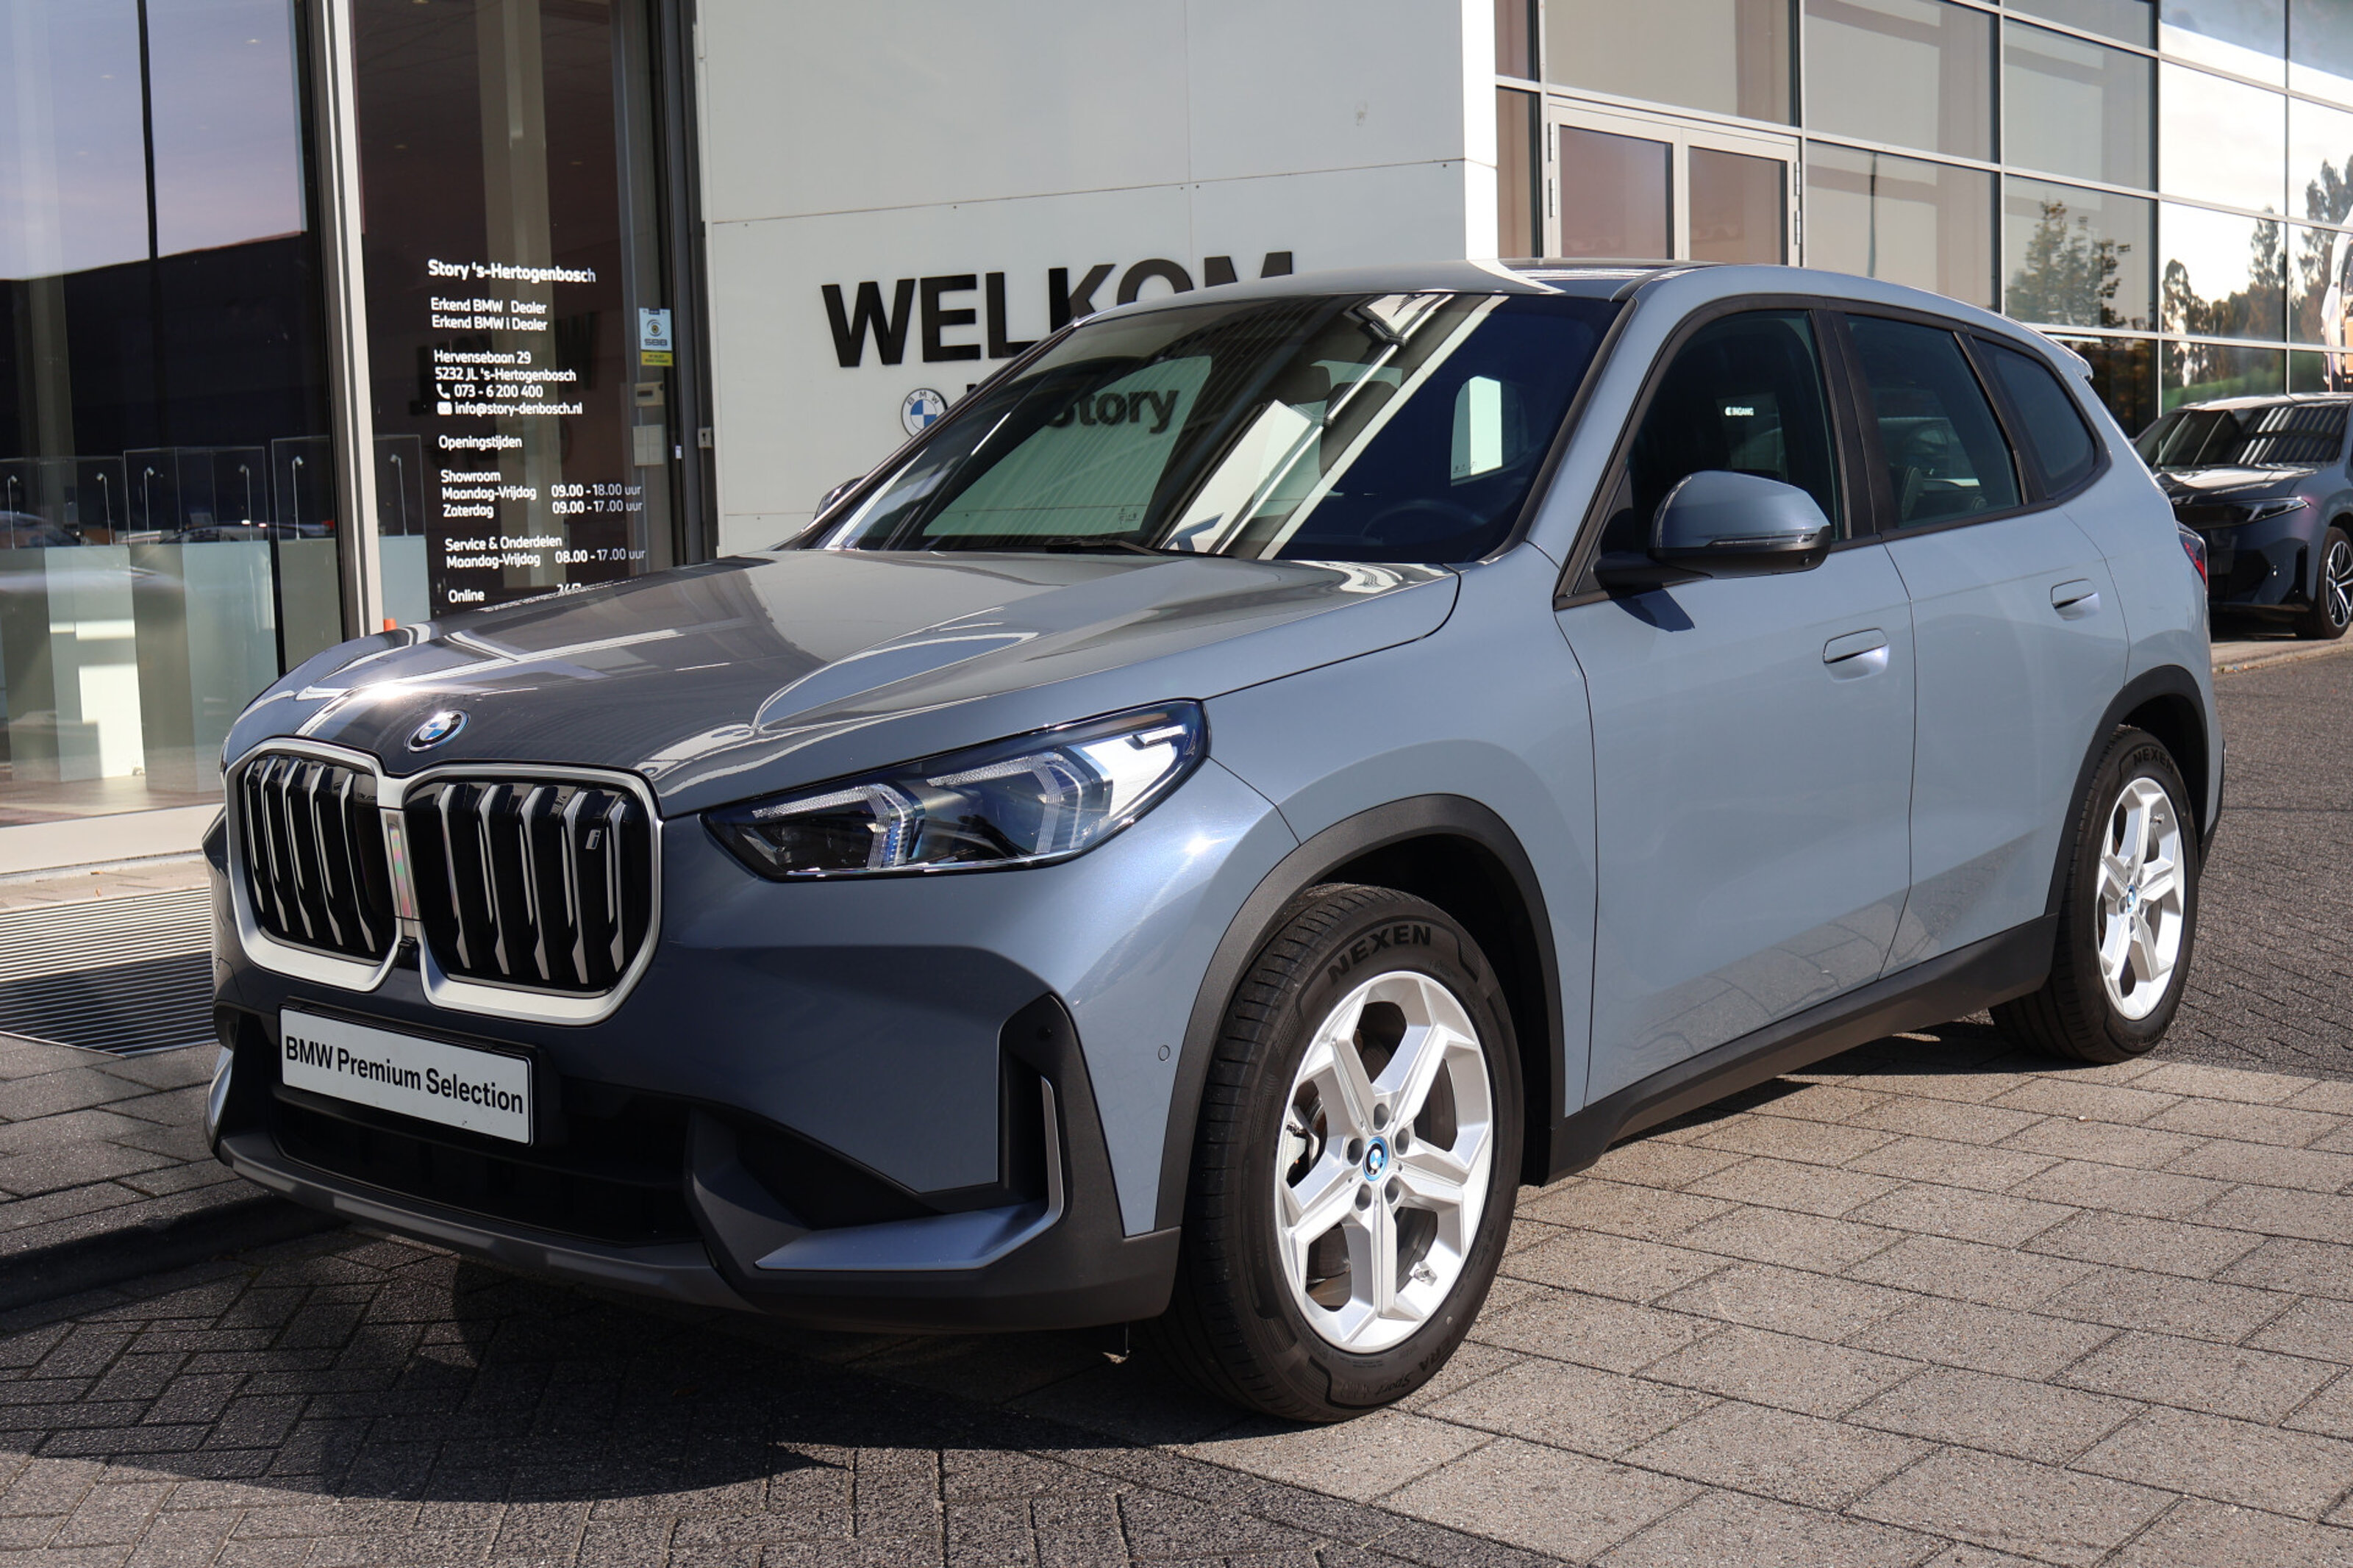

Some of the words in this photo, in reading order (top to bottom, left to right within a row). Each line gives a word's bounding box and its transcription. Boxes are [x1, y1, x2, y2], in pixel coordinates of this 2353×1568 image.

[427, 259, 470, 281] Story
[430, 297, 471, 312] Erkend
[473, 298, 503, 313] BMW
[510, 300, 548, 315] Dealer
[432, 315, 472, 330] Erkend
[474, 316, 504, 331] BMW
[506, 317, 510, 331] i
[512, 317, 549, 332] Dealer
[434, 349, 515, 365] Hervensebaan
[516, 351, 532, 365] 29
[435, 367, 464, 382] 5232
[465, 368, 479, 382] JL
[454, 384, 476, 398] 073
[486, 384, 494, 398] 6
[496, 384, 519, 398] 200
[521, 384, 544, 398] 400
[907, 391, 940, 406] BMW
[454, 401, 583, 418] info@story-denbosch.nl
[438, 435, 523, 451] Openingstijden
[440, 469, 501, 484] Showroom
[442, 485, 538, 502] Maandag-Vrijdag
[551, 484, 585, 498] 09.00
[592, 484, 622, 497] 18.00
[624, 486, 642, 496] uur
[443, 504, 495, 519] Zaterdag
[552, 500, 585, 515] 09.00
[626, 502, 643, 512] uur
[445, 537, 486, 553] Service
[488, 536, 499, 551] &
[500, 534, 563, 550] Onderdelen
[446, 554, 541, 570] Maandag-Vrijdag
[554, 550, 588, 564] 08.00
[629, 550, 646, 560] uur
[448, 589, 485, 604] Online
[1327, 925, 1432, 985] NEXEN
[285, 1035, 333, 1071] BMW
[337, 1047, 422, 1091] Premium
[425, 1067, 524, 1114] Selection
